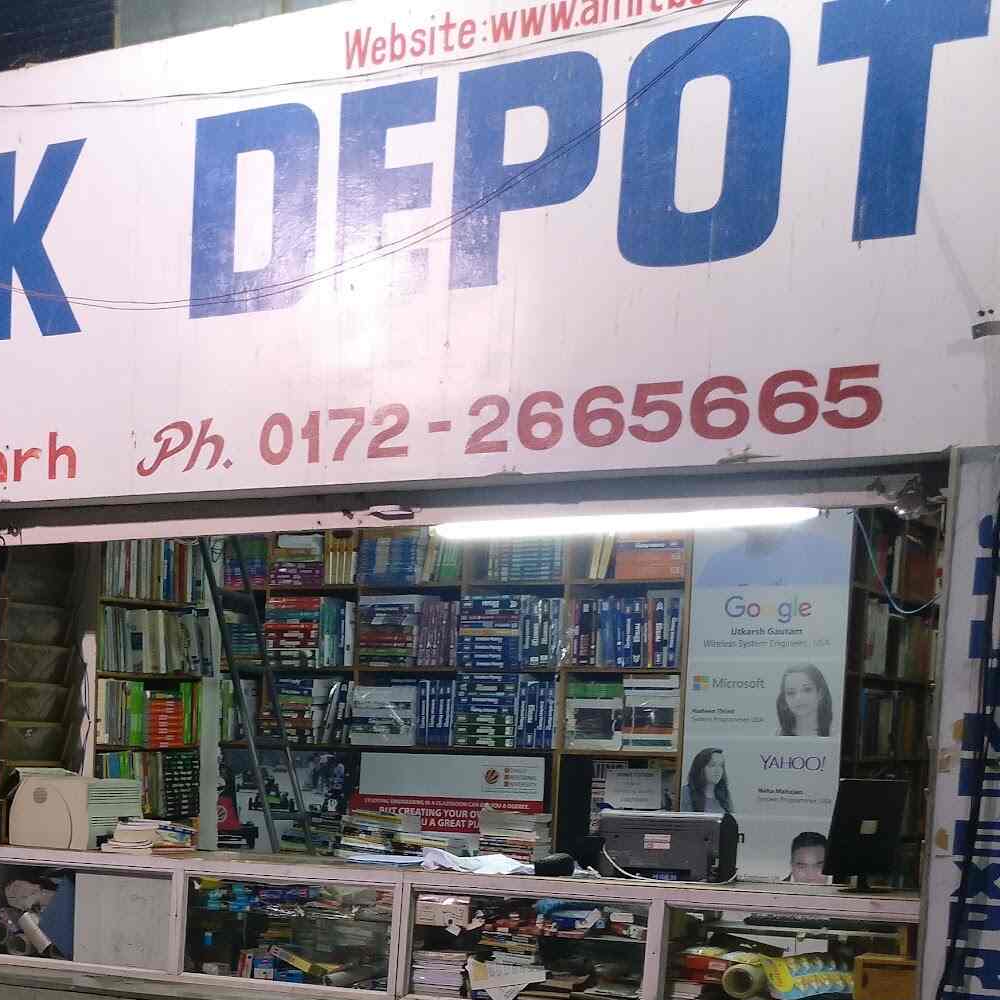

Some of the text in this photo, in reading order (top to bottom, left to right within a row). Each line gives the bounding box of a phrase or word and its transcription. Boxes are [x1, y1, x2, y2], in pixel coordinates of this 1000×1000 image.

[189, 0, 990, 319] DEPOT
[136, 418, 233, 476] Ph.
[712, 678, 766, 689] Microsoft
[759, 752, 827, 772] YAHOO!
[398, 806, 442, 817] CREATING
[443, 808, 469, 818] YOUR
[437, 819, 467, 828] GREAT
